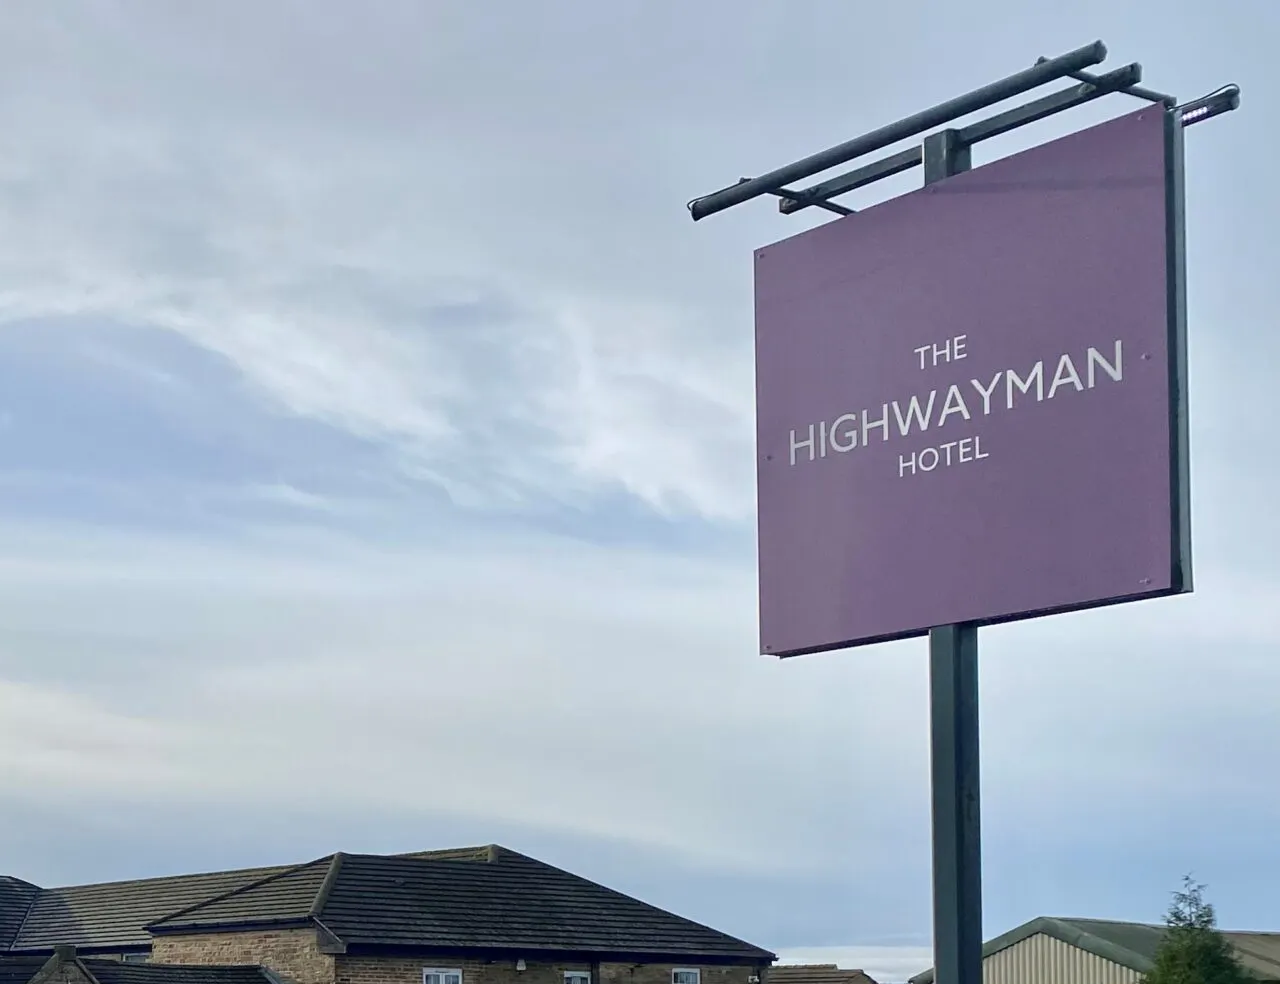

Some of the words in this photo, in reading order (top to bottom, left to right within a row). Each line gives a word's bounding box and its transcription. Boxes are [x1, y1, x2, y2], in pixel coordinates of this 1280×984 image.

[914, 335, 968, 370] THE
[789, 340, 1123, 466] HIGHWAYMAN
[898, 436, 989, 477] HOTEL
